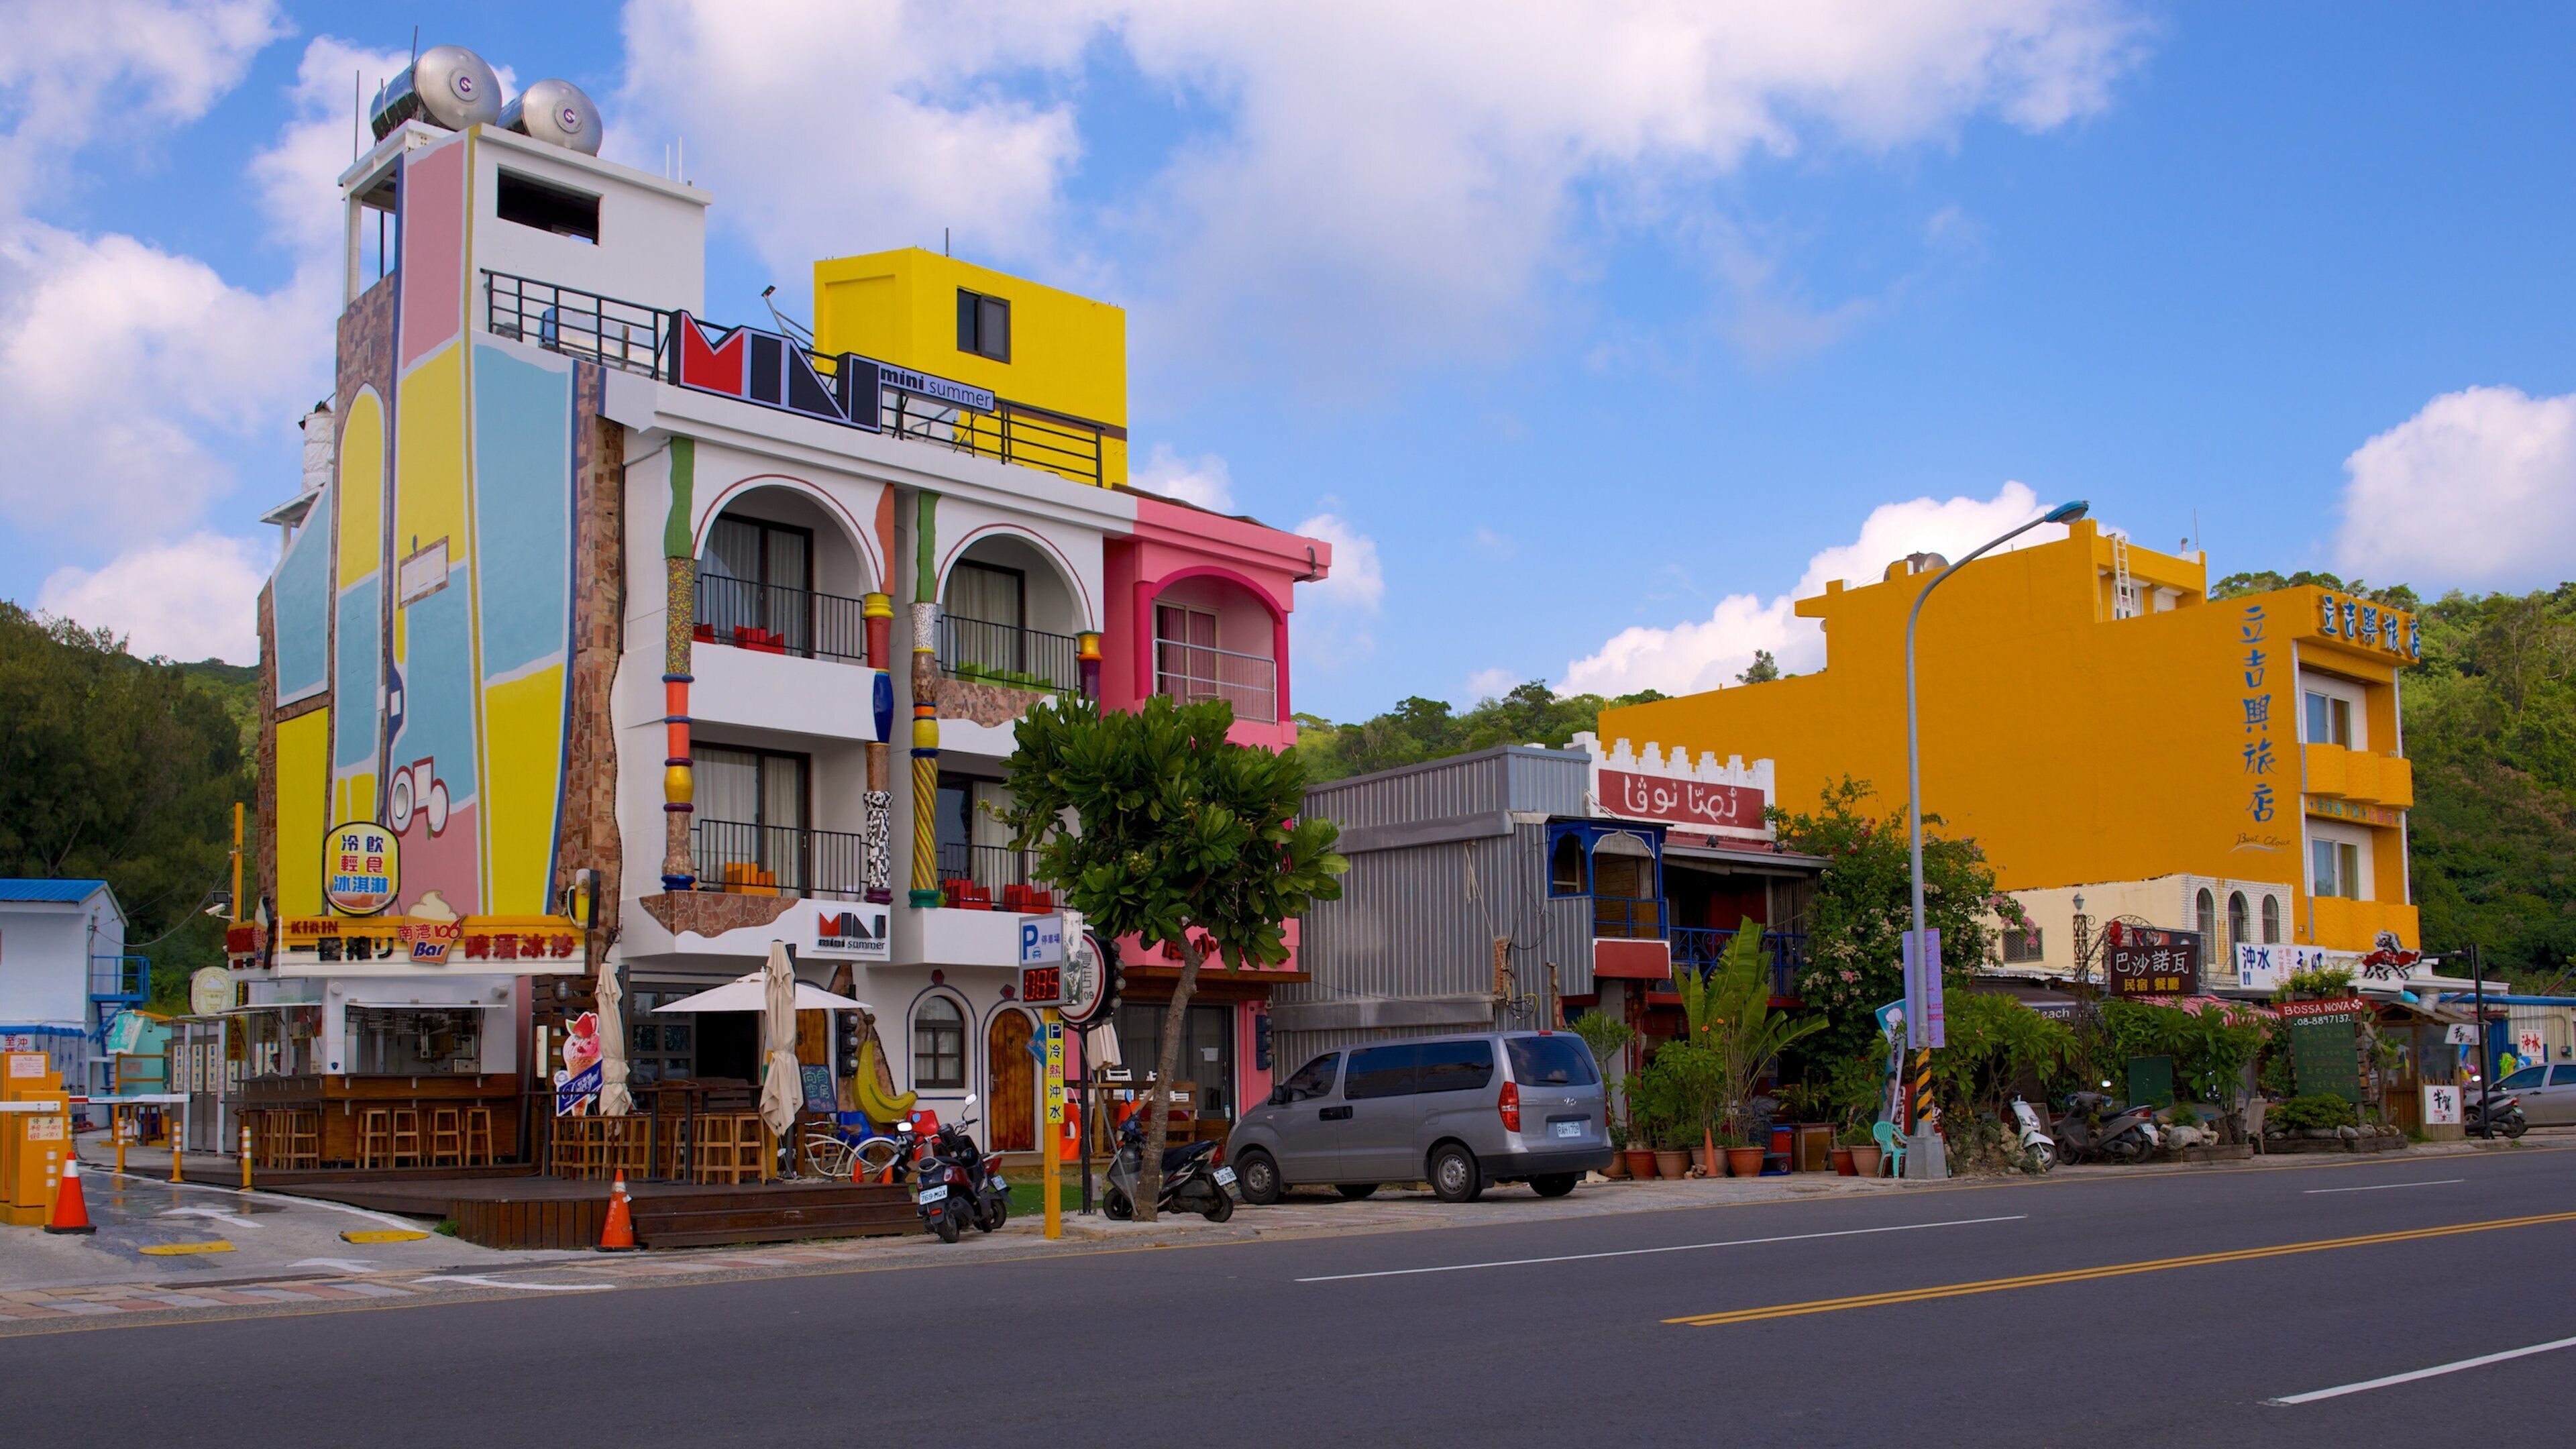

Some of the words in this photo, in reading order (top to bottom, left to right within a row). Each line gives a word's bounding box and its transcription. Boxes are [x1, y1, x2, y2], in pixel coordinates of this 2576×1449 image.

[681, 310, 879, 430] MINI
[881, 367, 924, 390] mini
[929, 379, 991, 408] summer
[2323, 595, 2420, 658] 立吉興旅店
[2239, 605, 2277, 822] 立吉興旅店
[341, 835, 383, 853] 冷飲
[341, 855, 383, 873] 輕食
[333, 875, 388, 894] 冰淇淋
[290, 920, 338, 934] KIRIN
[818, 912, 886, 938] MINI
[818, 938, 845, 947] mini
[847, 940, 885, 949] summer
[1022, 924, 1038, 961] P
[1041, 933, 1060, 945] 停車場
[414, 942, 445, 956] Bar
[2242, 946, 2271, 969] 沖水
[2116, 949, 2189, 977] 巴沙諾瓦
[1024, 968, 1059, 1000] 085
[2124, 977, 2148, 991] 民宿
[2284, 1004, 2322, 1016] BOSSA
[2324, 1000, 2351, 1012] NOVA
[1051, 1024, 1061, 1038] P
[1049, 1044, 1061, 1118] 冷熱沖水
